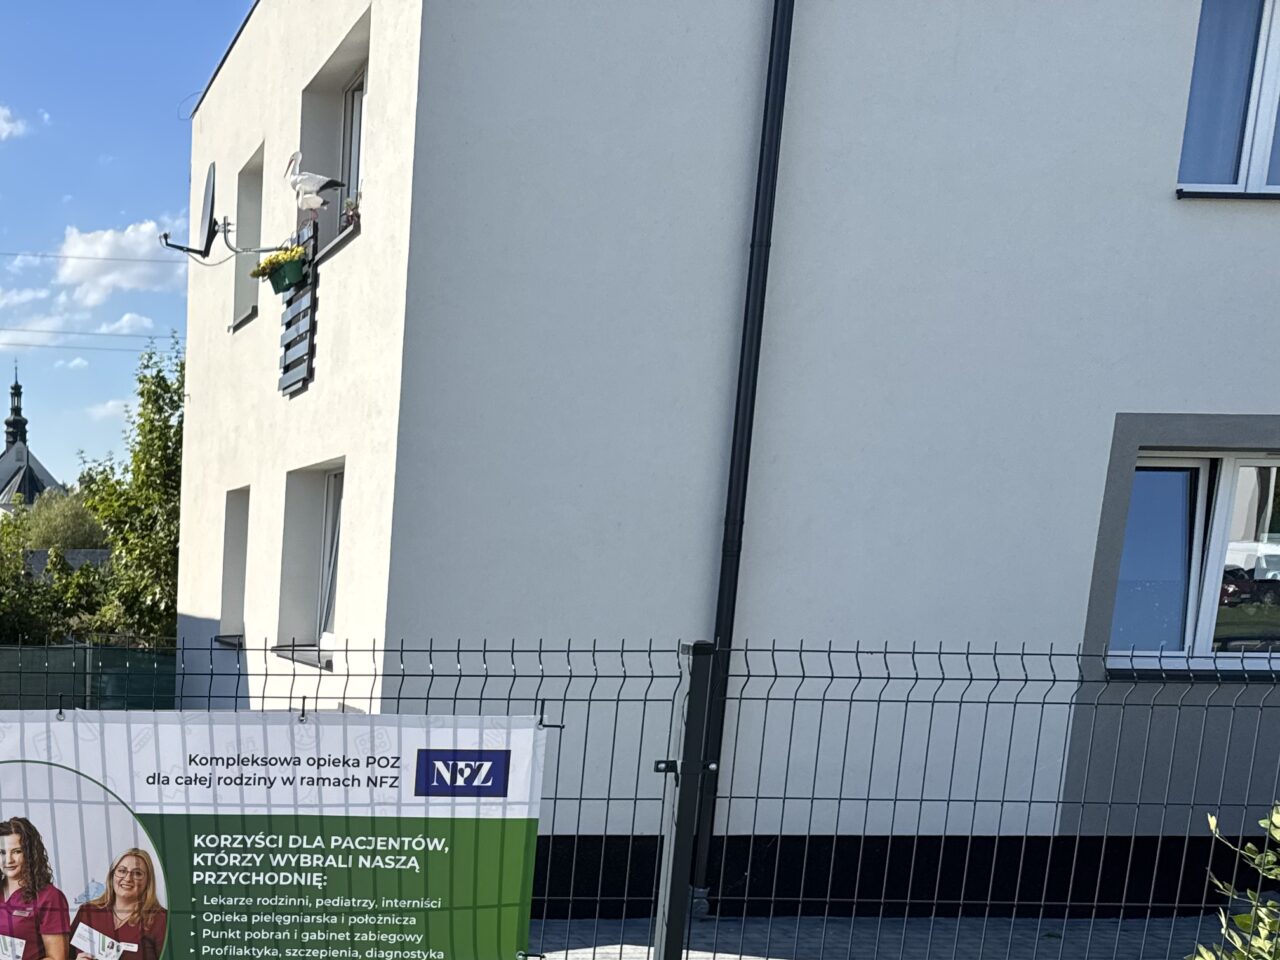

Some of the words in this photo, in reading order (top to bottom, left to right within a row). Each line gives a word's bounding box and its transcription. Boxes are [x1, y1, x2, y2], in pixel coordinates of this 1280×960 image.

[187, 753, 302, 770] Kompleksowa
[306, 754, 361, 770] opieka
[366, 756, 401, 770] POZ
[145, 772, 170, 786] dla
[174, 772, 213, 789] całej
[216, 773, 276, 789] rodziny
[281, 777, 296, 786] w
[298, 774, 361, 788] ramach
[366, 776, 400, 789] NFZ
[430, 760, 494, 786] NFZ
[193, 832, 283, 849] KORZYŚCI
[287, 834, 326, 849] DLA
[330, 834, 449, 854] PACJENTÓW,
[192, 849, 264, 867] KTÓRZY
[268, 853, 353, 868] WYBRALI
[356, 854, 420, 873] NASZĄ
[192, 871, 328, 890] PRZYCHODNIĘ:
[202, 895, 253, 907] Lekarze
[256, 895, 312, 909] rodzinni,
[315, 896, 378, 909] pediatrzy,
[381, 896, 442, 909] interniści
[202, 912, 248, 924] Opieka
[251, 913, 337, 926] pielęgniarska
[341, 913, 346, 924] i
[348, 913, 417, 926] położnicza
[202, 929, 241, 941] Punkt
[244, 929, 291, 943] pobrań
[294, 930, 298, 941] i
[300, 930, 350, 943] gabinet
[354, 931, 424, 944] zabiegowy
[201, 945, 281, 958] Profilaktyka,
[285, 947, 362, 960] szczepienia,
[365, 947, 445, 960] diagnostyka
